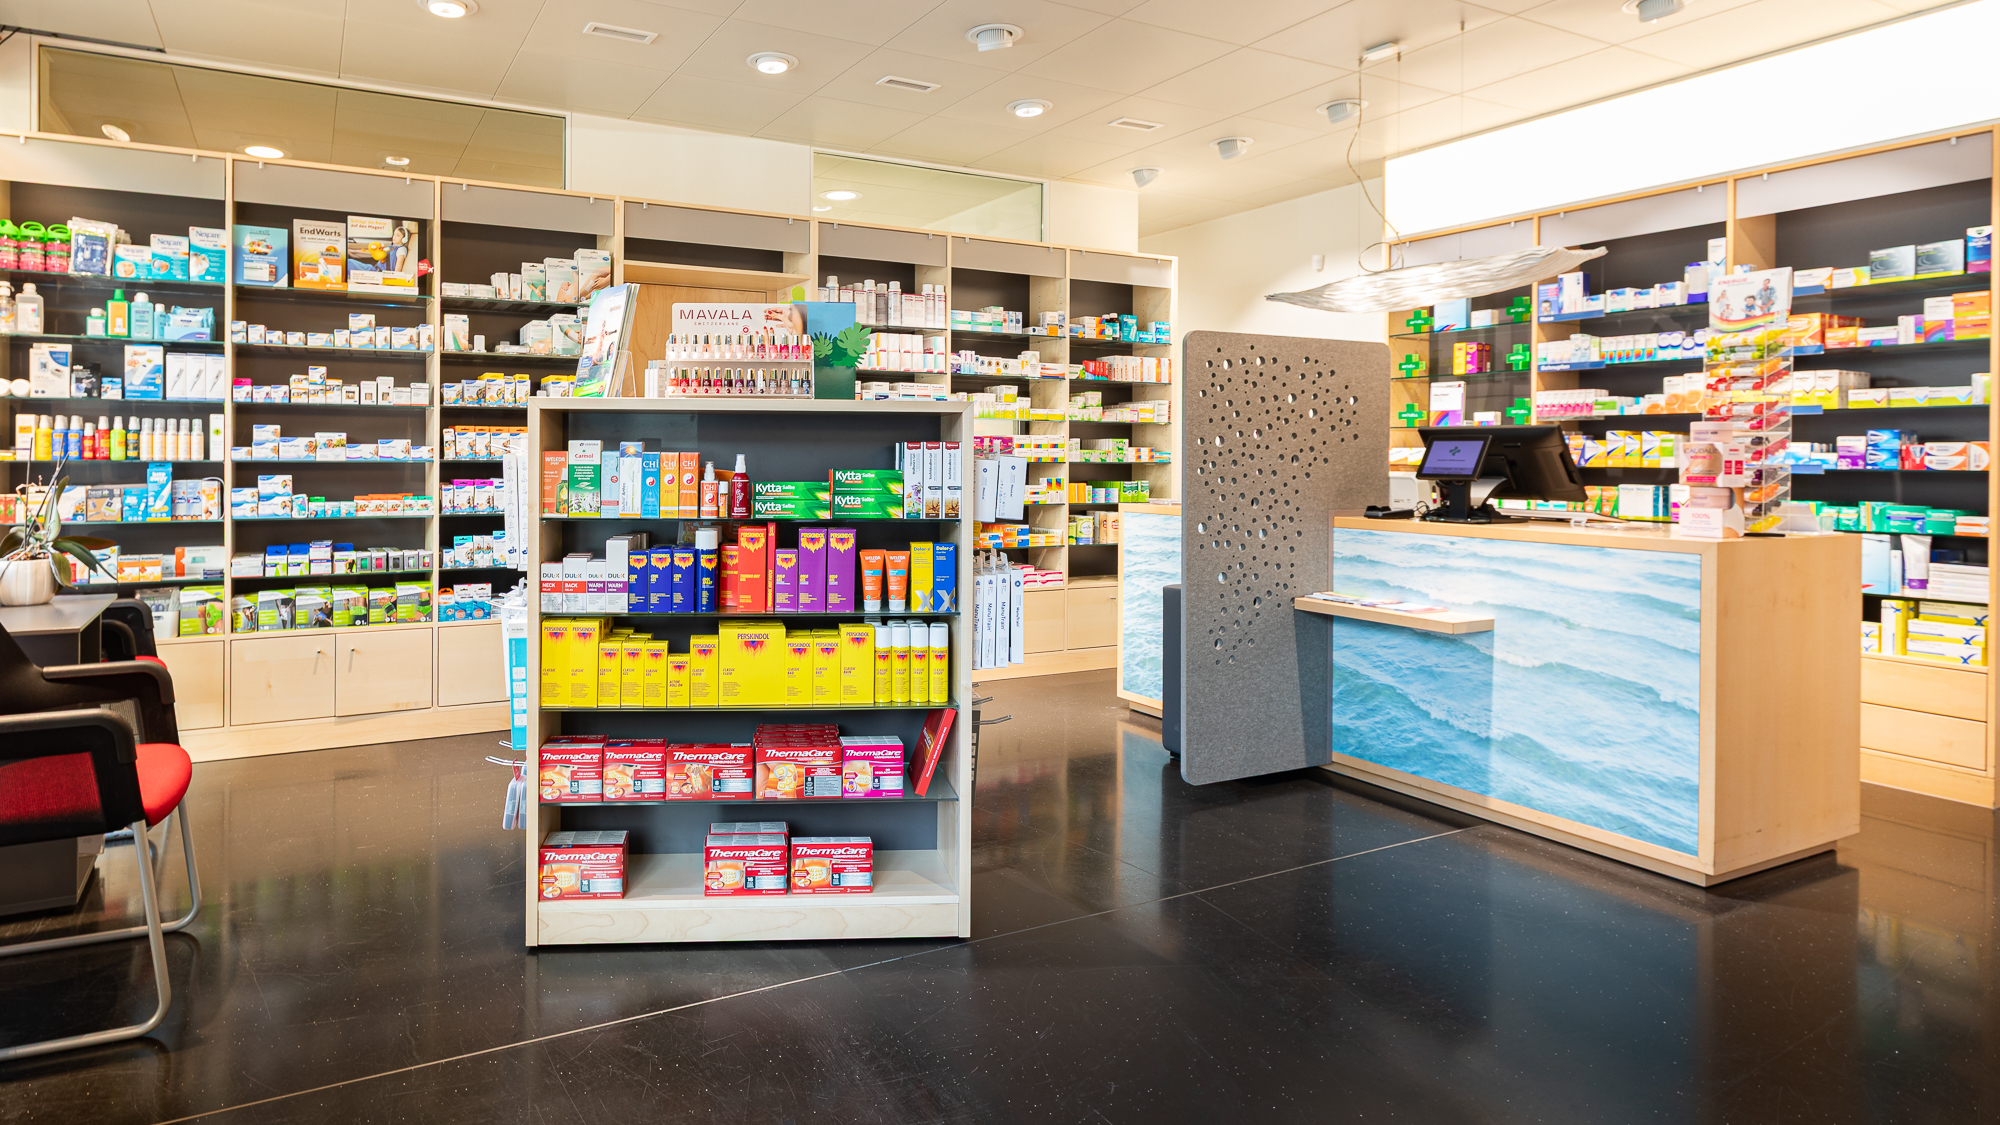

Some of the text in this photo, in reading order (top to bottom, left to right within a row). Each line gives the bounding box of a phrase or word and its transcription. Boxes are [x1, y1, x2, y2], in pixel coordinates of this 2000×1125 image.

[196, 230, 221, 239] Nexcare
[300, 227, 341, 237] EndWarts
[157, 238, 183, 246] Nexcare
[1718, 277, 1748, 286] ENERGIE
[679, 309, 752, 320] MAVALA
[836, 471, 862, 482] Kytta
[755, 483, 781, 494] Kytta
[835, 496, 861, 506] Kytta
[755, 502, 781, 513] Kytta
[542, 753, 600, 761] ThermaCare
[606, 752, 662, 760] ThermaCare
[673, 752, 745, 761] ThermaCare
[766, 749, 834, 757] ThermaCare
[710, 849, 782, 858] ThermaCare
[796, 847, 868, 855] ThermaCare
[544, 852, 618, 861] ThermaCare
